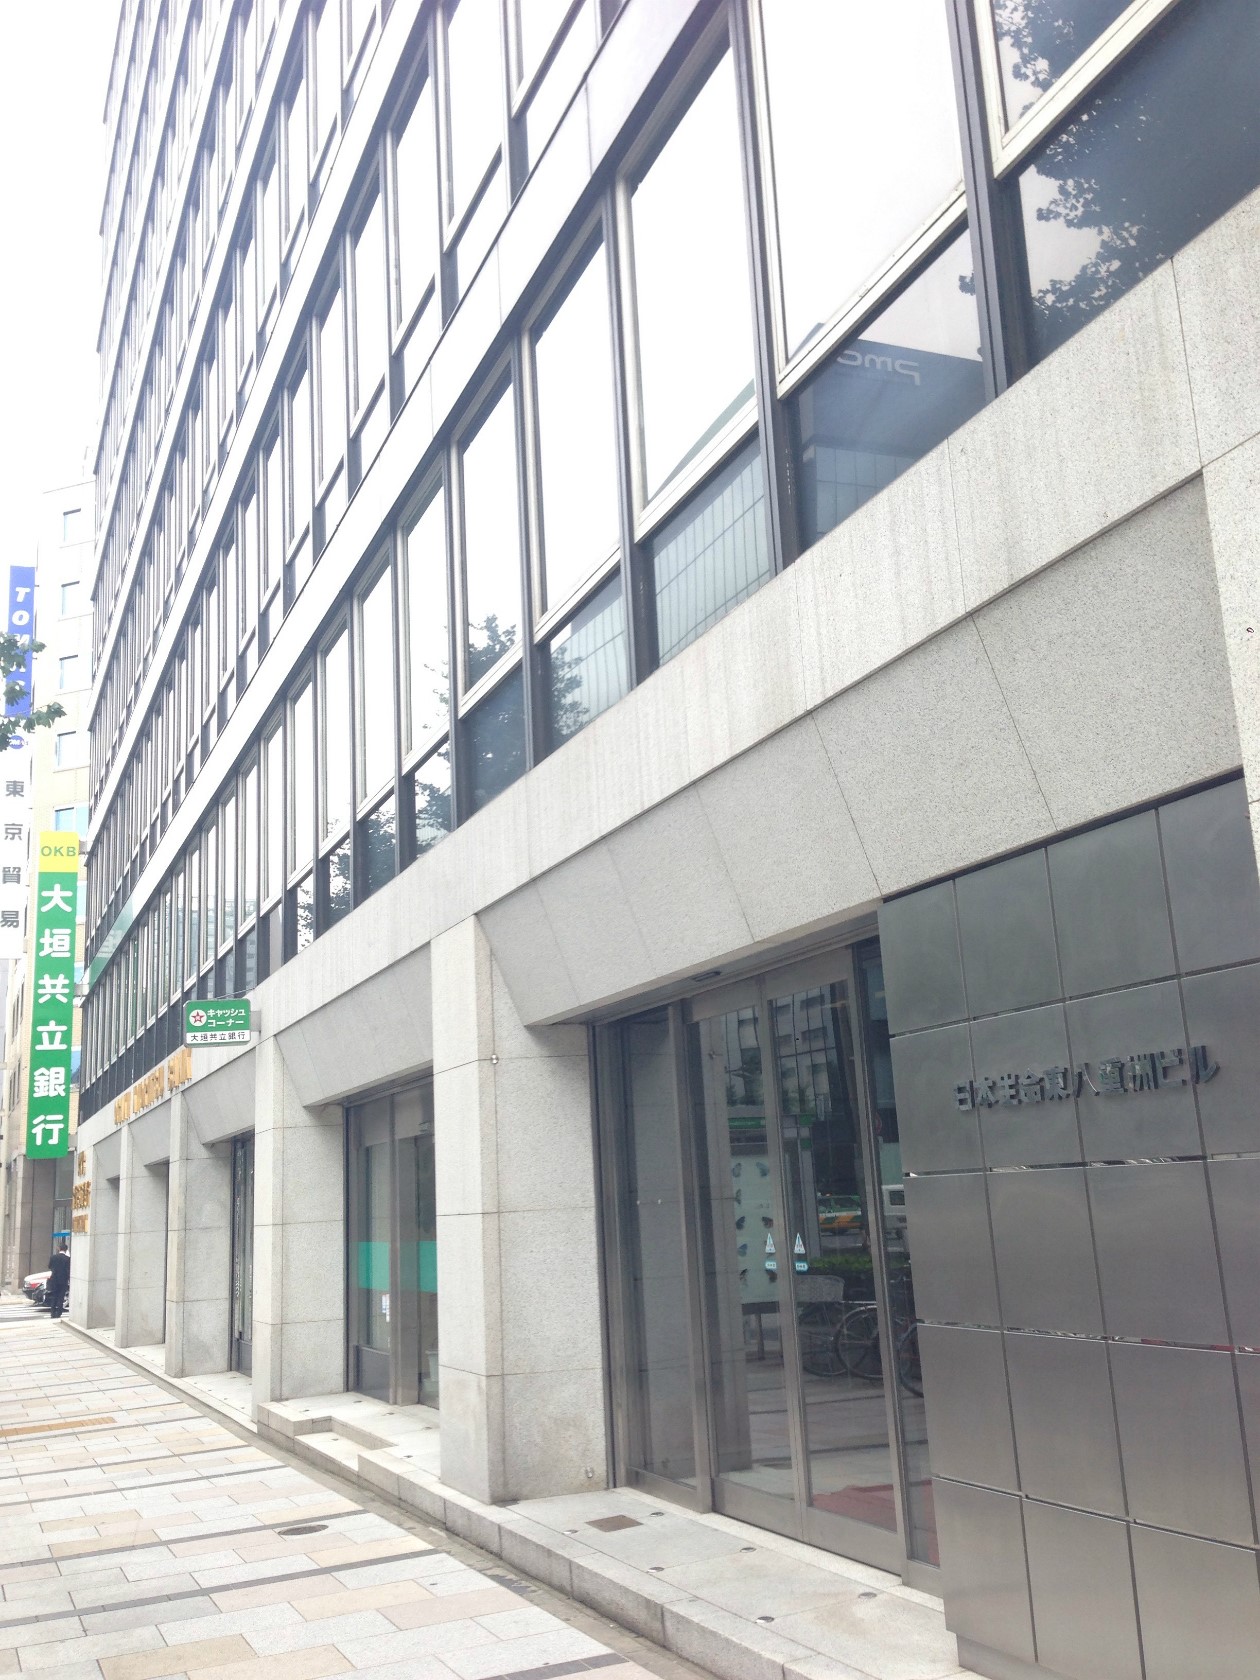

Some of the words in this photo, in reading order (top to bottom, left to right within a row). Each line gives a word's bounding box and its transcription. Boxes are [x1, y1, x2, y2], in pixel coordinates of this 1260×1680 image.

[0, 780, 25, 929] 東京貿易
[40, 845, 77, 857] OKB
[31, 883, 73, 1146] 大垣共立銀行
[207, 1008, 246, 1018] キャッシュ
[207, 1018, 244, 1027] コーナー
[190, 1031, 246, 1042] 大垣共立銀行
